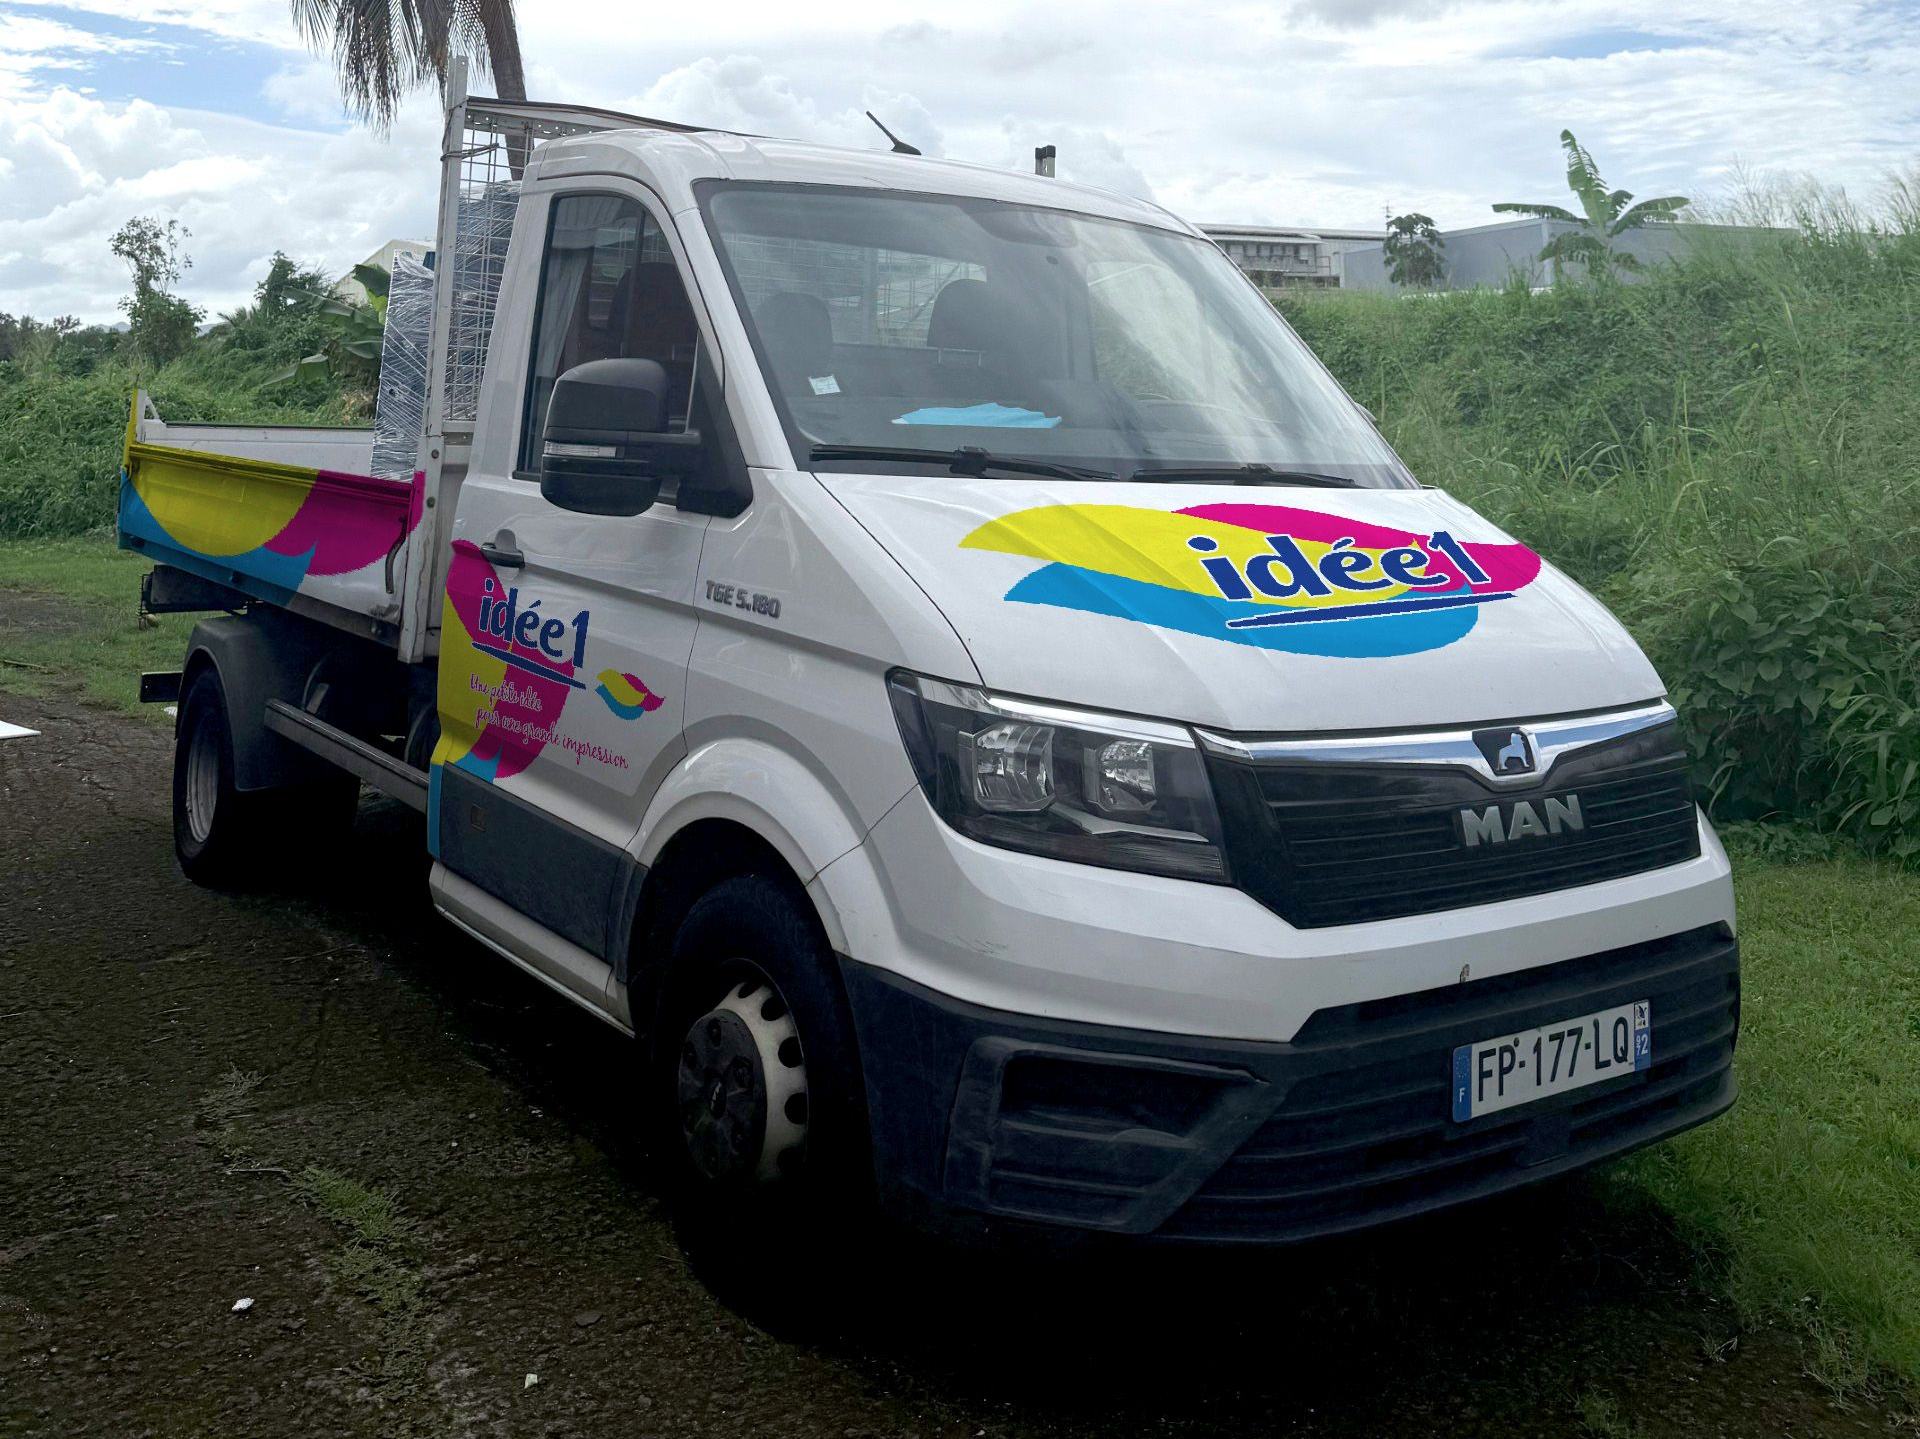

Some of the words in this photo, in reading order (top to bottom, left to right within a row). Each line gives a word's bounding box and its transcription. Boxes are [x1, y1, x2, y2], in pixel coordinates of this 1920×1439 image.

[1186, 530, 1491, 601] idée1
[478, 577, 590, 669] idée1
[706, 580, 735, 605] TGE
[735, 588, 781, 619] 5.180
[475, 708, 501, 729] pour
[562, 735, 629, 769] impression
[1460, 794, 1585, 847] MAN
[1477, 1015, 1629, 1103] FP-177-LQ
[1458, 1087, 1466, 1103] F
